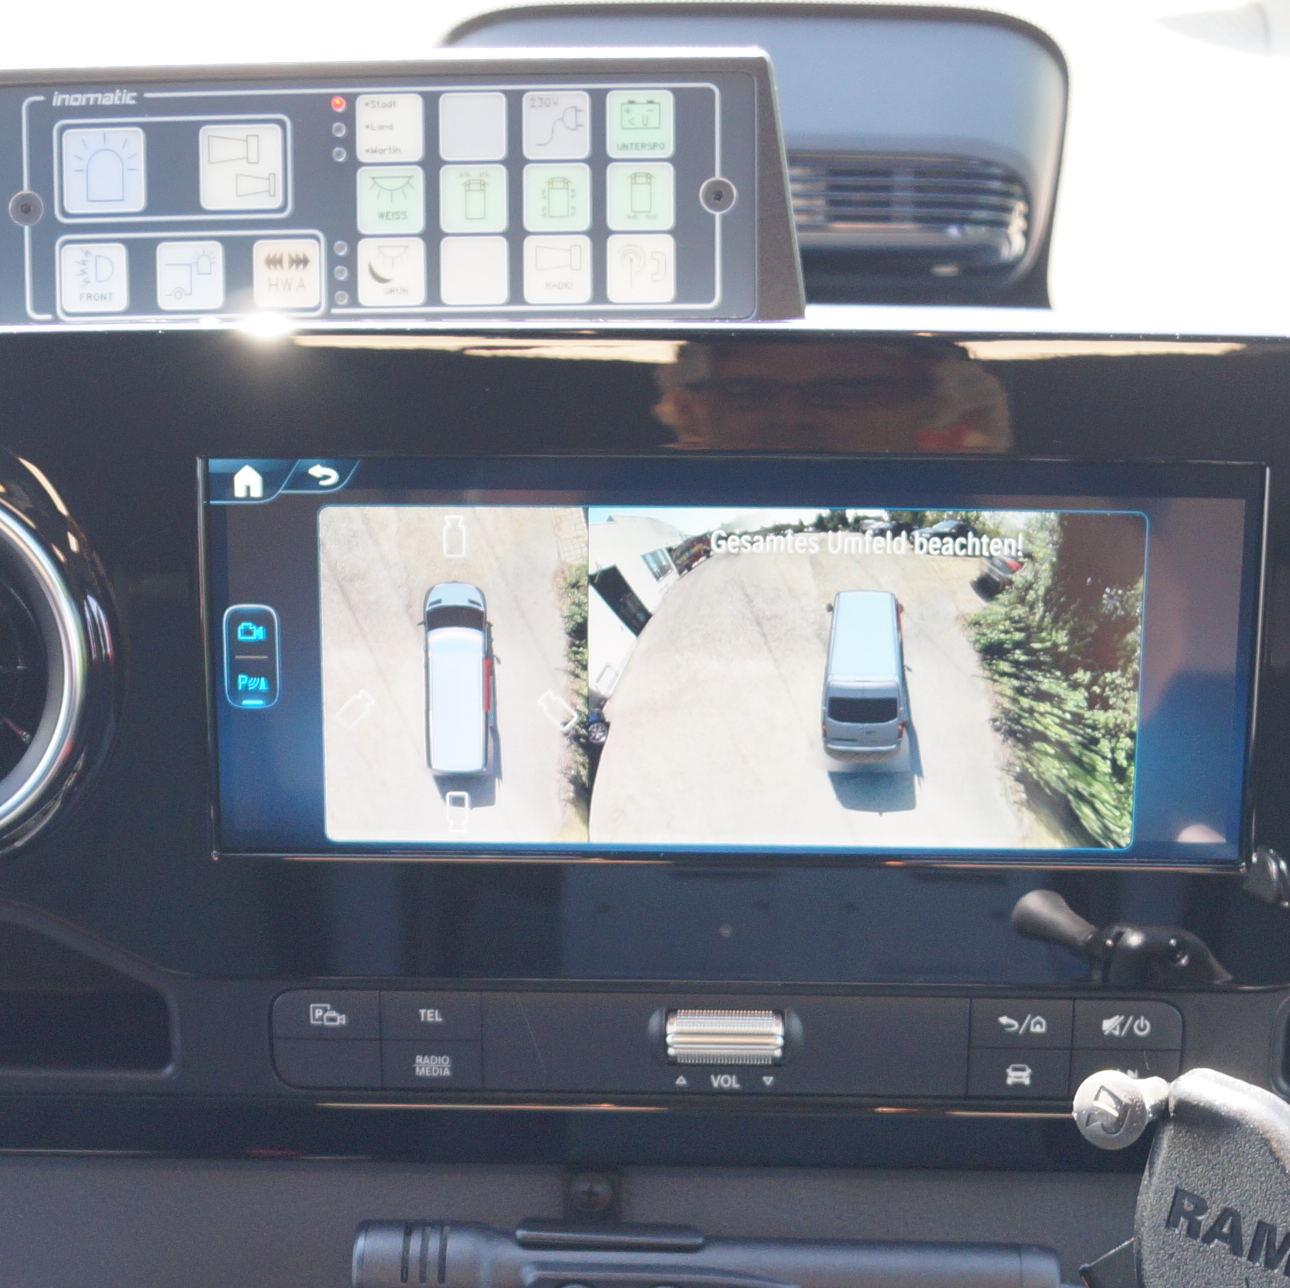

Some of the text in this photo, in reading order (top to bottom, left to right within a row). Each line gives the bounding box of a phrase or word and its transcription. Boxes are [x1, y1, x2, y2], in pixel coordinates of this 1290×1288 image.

[51, 89, 138, 107] inomatic
[529, 97, 559, 109] 230V
[377, 210, 408, 221] WEISS
[79, 291, 114, 303] FRONT
[710, 529, 1024, 558] Gesamtes Umfeld beachten!
[418, 1008, 443, 1022] TEL
[415, 1054, 450, 1065] RADIO
[415, 1066, 451, 1077] MEDIA
[710, 1074, 741, 1088] VOL
